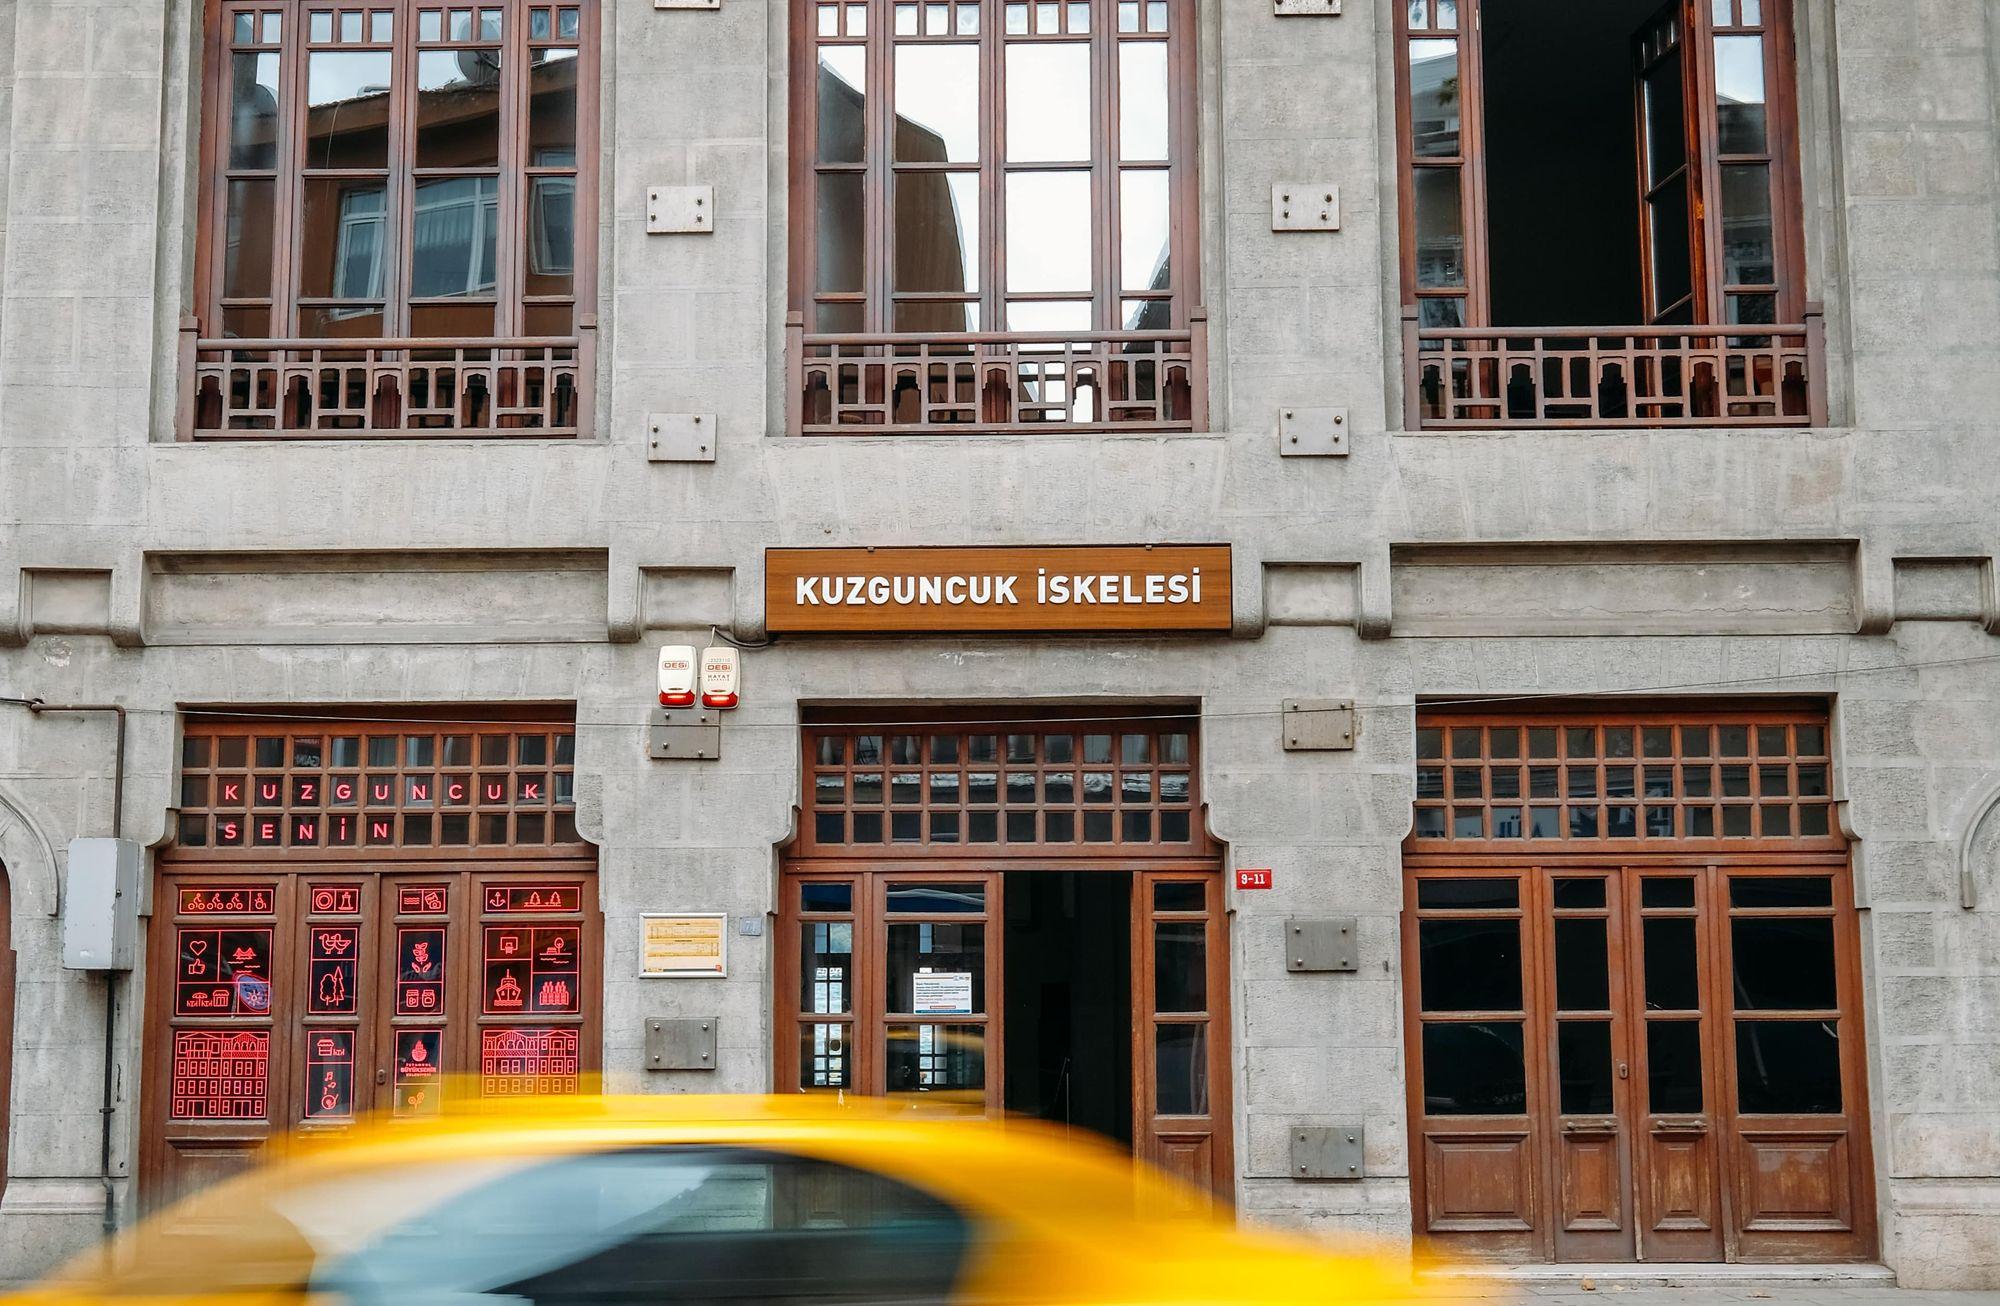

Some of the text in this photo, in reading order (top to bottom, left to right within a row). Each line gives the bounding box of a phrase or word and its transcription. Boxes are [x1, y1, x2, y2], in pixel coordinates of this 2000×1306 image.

[796, 567, 1201, 605] KUZGUNCUK İSKELESİ
[223, 784, 540, 801] KUZGUNCUK
[224, 817, 389, 841] SENİN
[1241, 873, 1265, 885] 9-11
